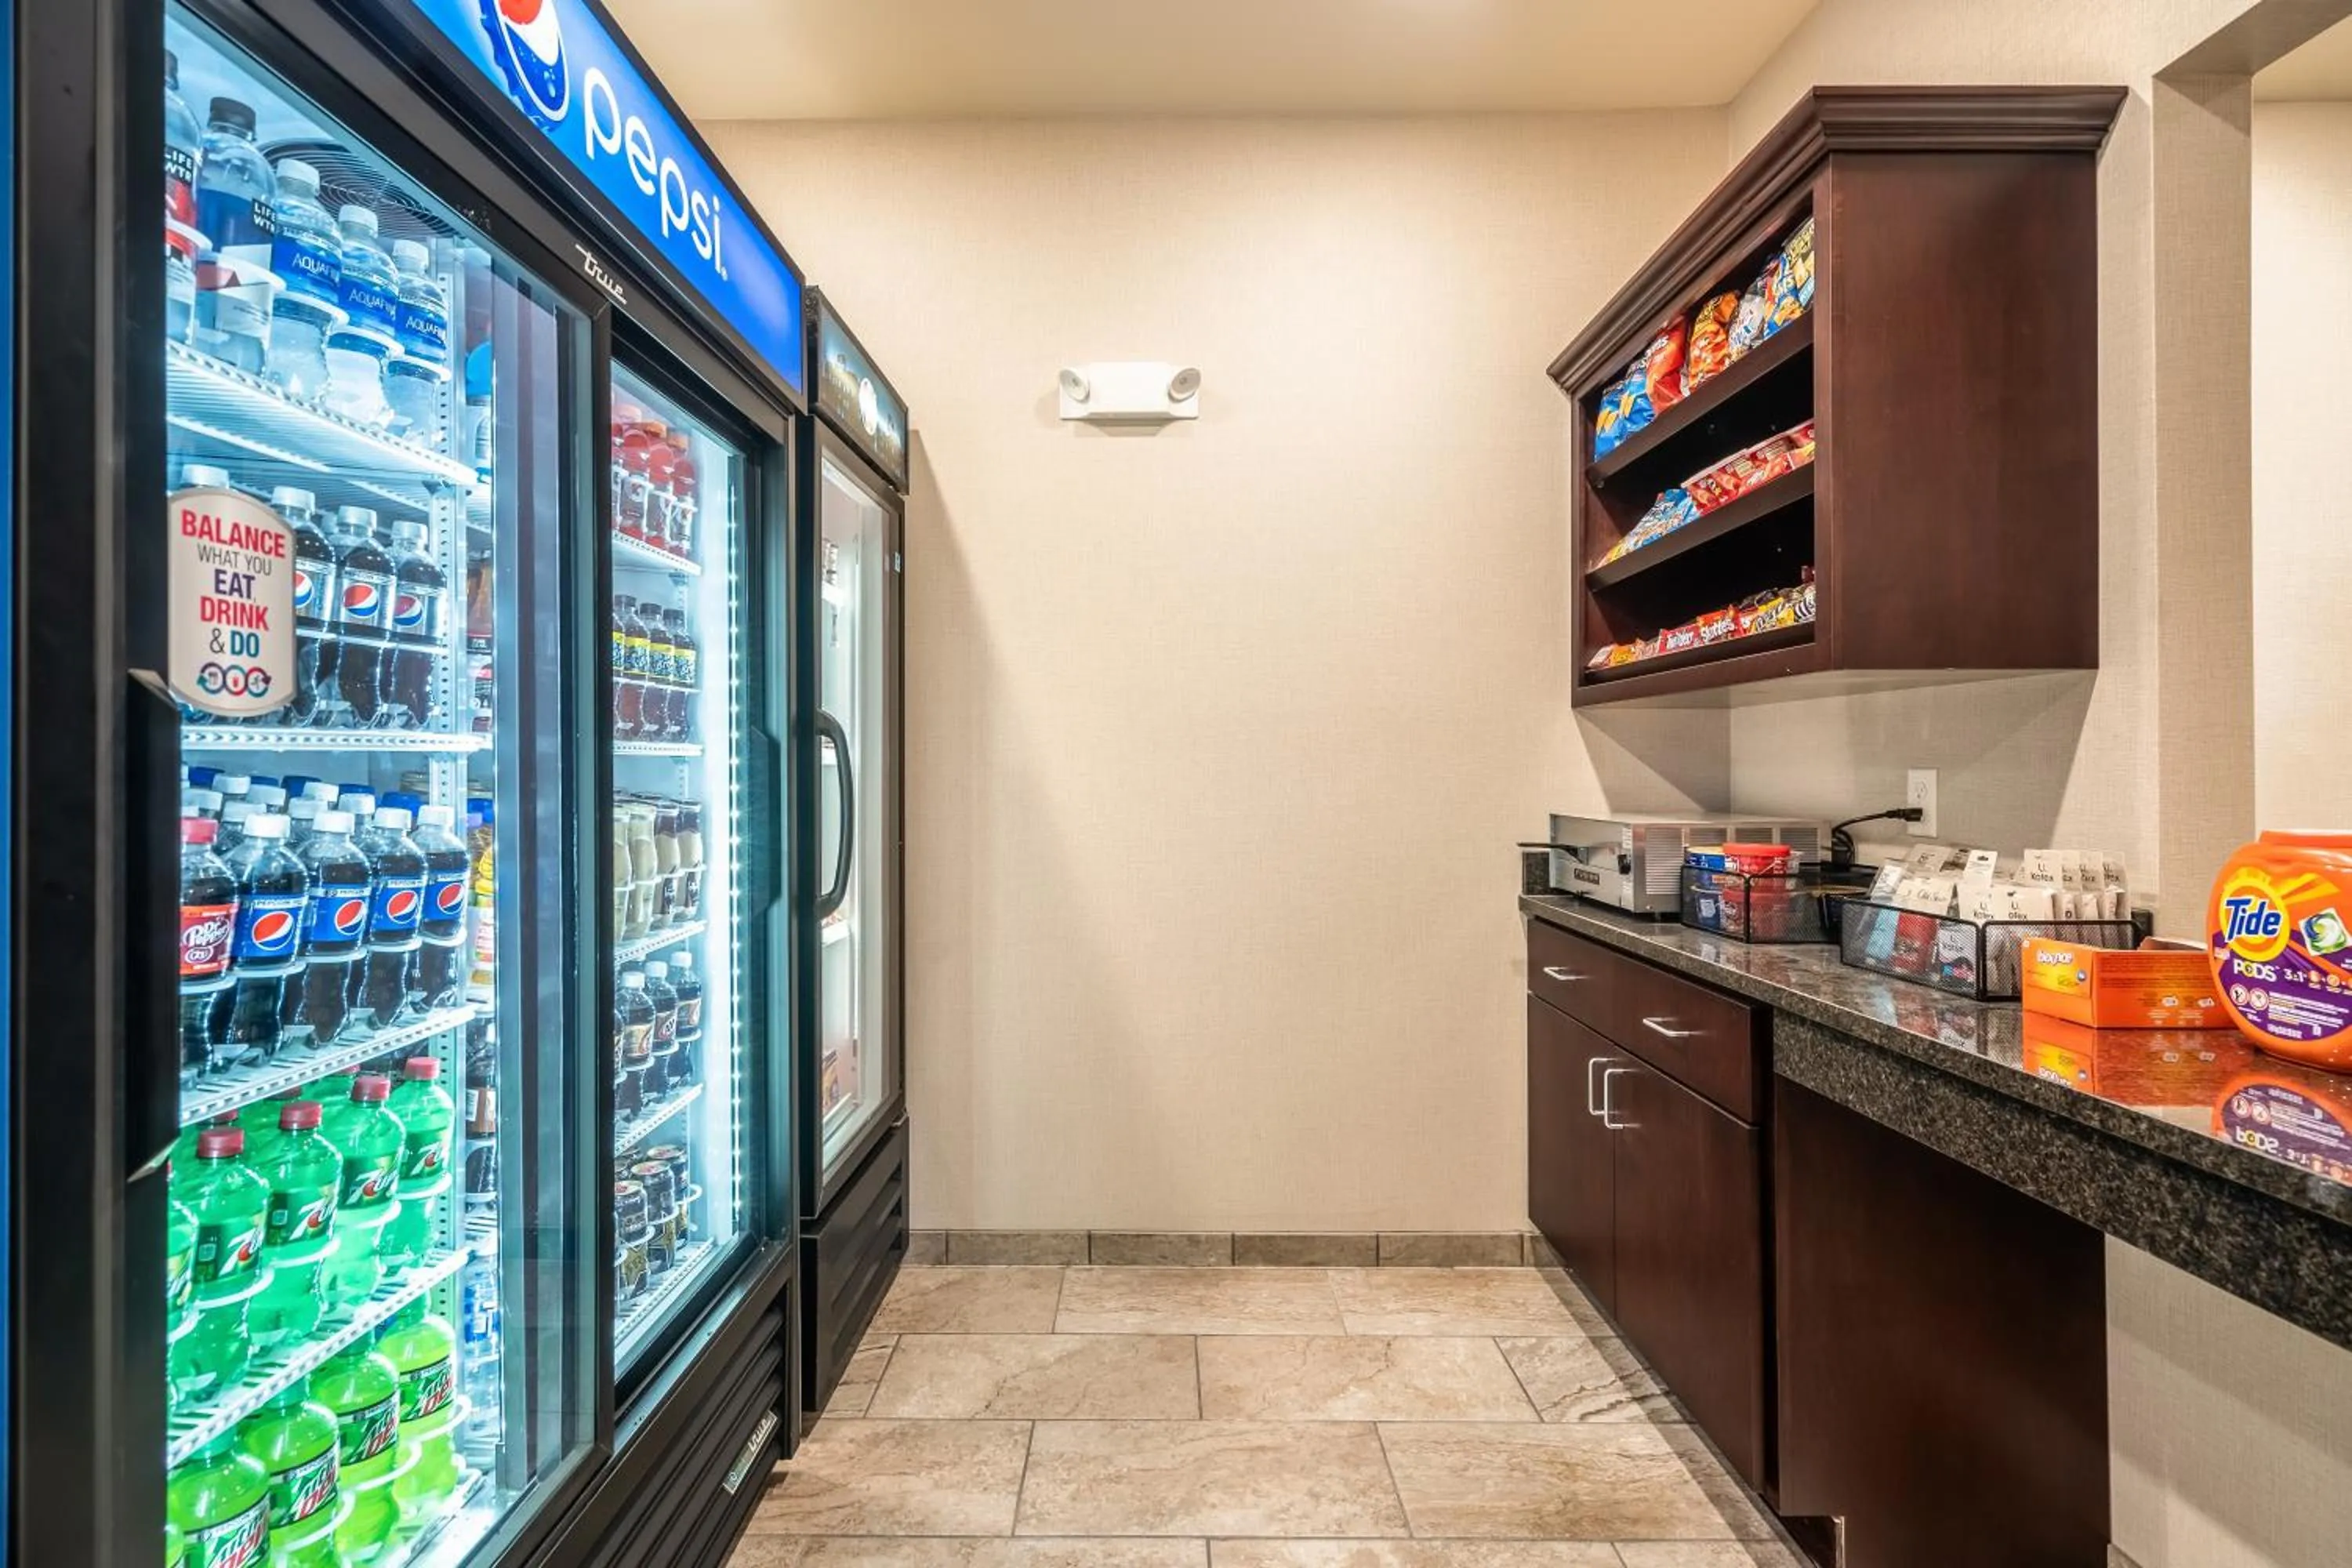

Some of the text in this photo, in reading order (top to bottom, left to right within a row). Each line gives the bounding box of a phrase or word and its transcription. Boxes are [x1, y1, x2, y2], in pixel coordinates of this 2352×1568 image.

[583, 67, 723, 274] pepsi
[181, 508, 285, 558] BALANCE
[198, 543, 272, 576] WHAT YOU
[200, 596, 269, 631] DRINK
[209, 628, 260, 658] & DO
[2226, 897, 2281, 942] Tide
[2234, 958, 2278, 982] PODS
